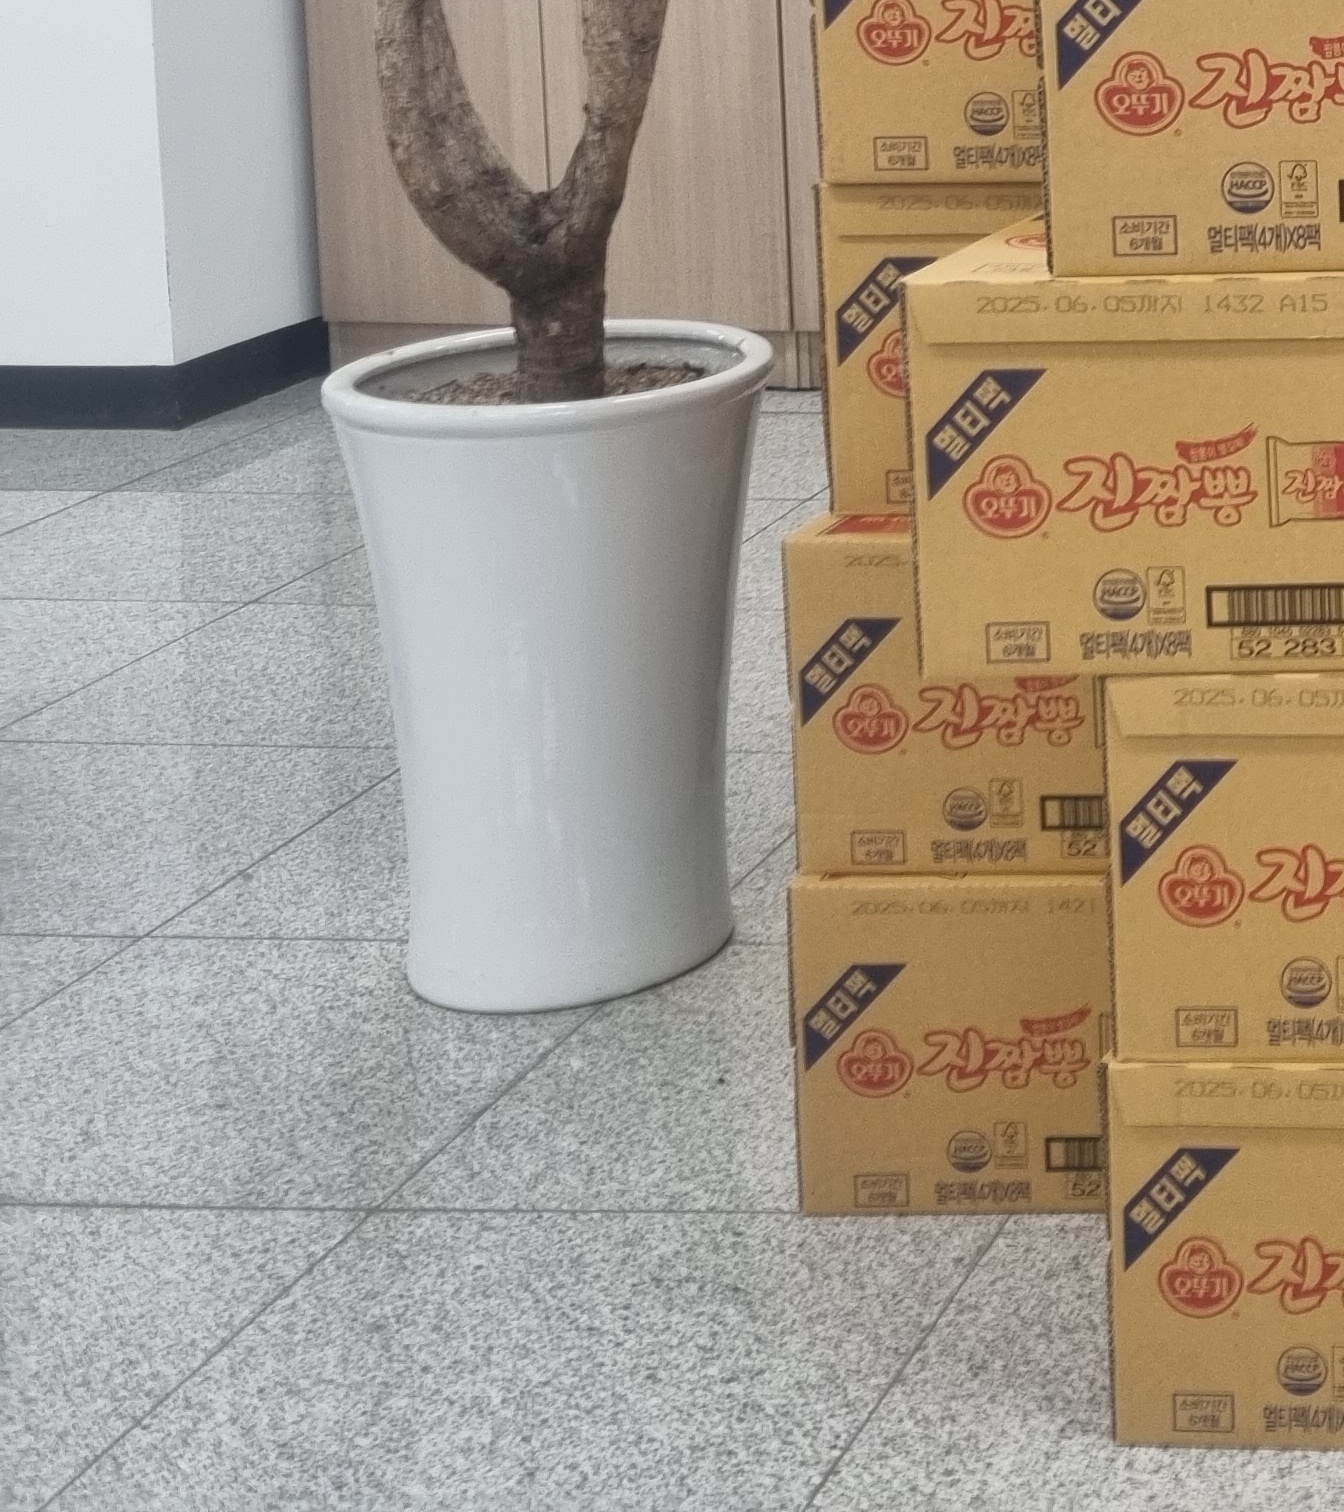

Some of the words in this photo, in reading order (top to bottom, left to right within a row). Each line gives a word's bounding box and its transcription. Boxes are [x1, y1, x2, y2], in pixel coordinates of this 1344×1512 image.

[1111, 92, 1169, 116] 오뚜기
[1204, 294, 1265, 313] 1432
[931, 375, 1012, 460] 멀티팩
[1055, 451, 1259, 534] 진짬뽕
[977, 495, 1038, 521] 오뚜기
